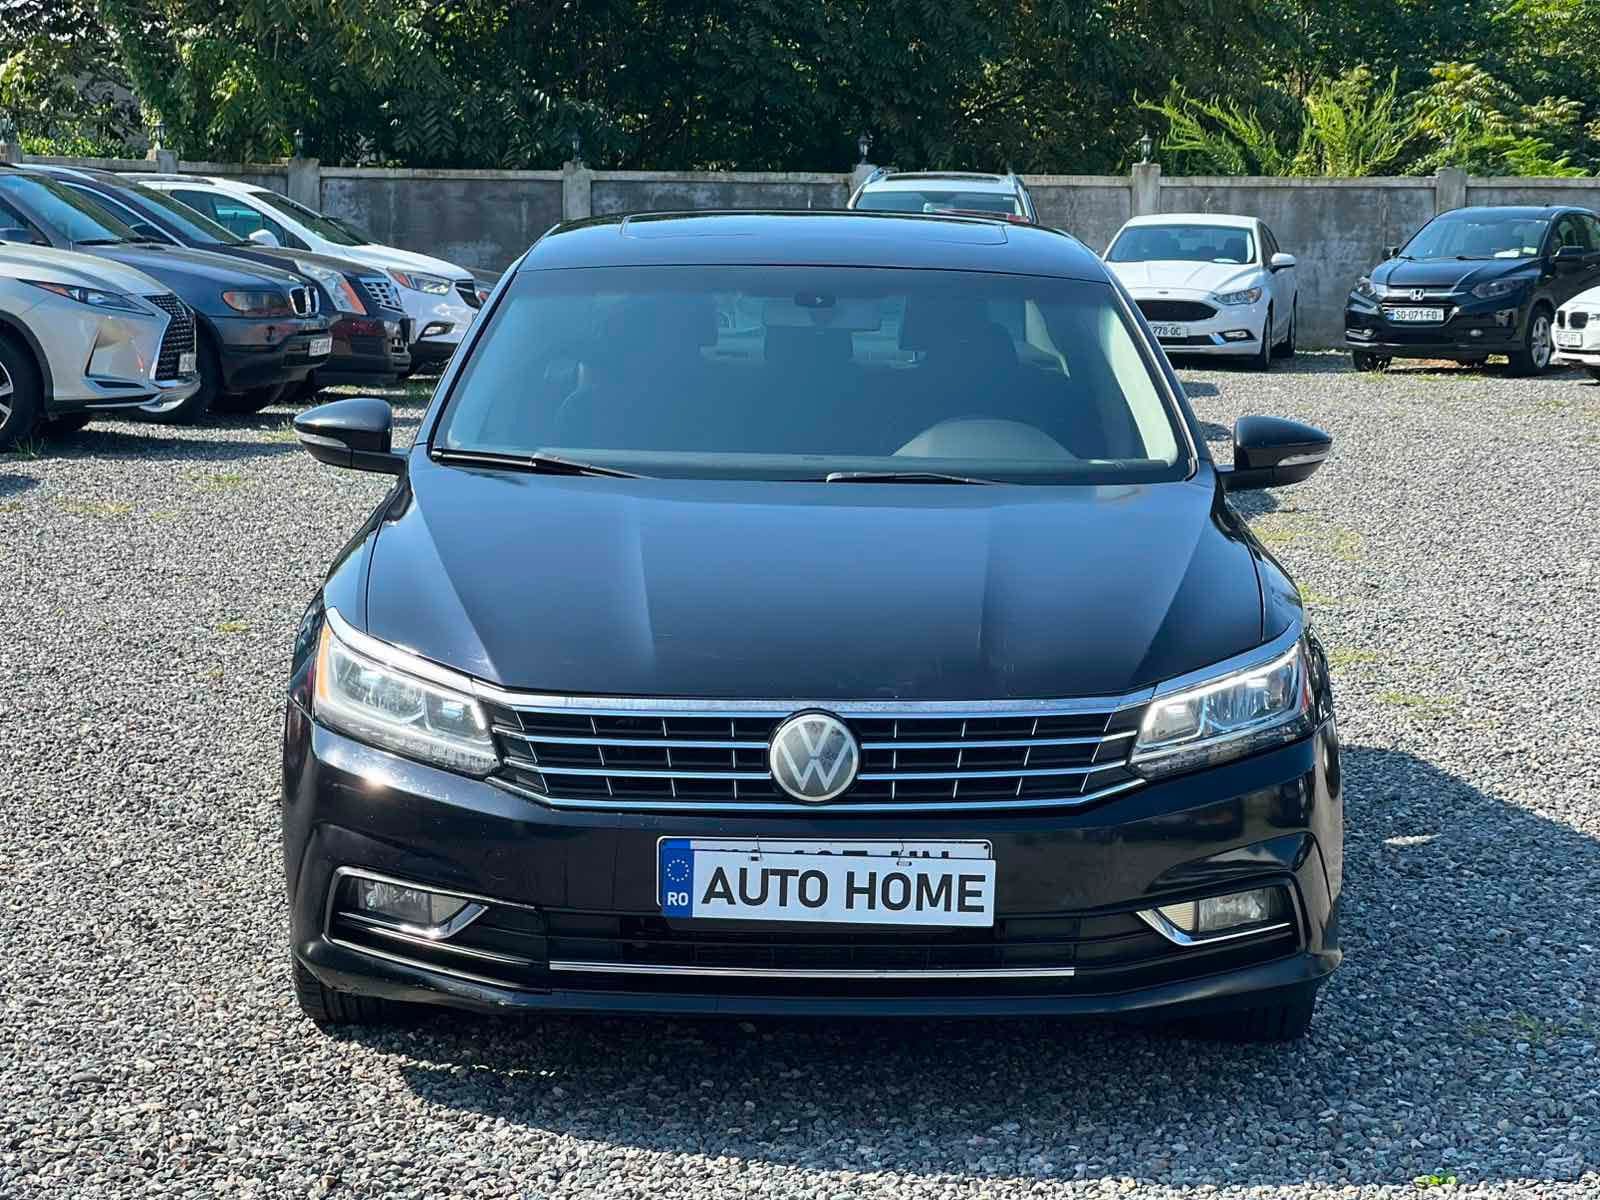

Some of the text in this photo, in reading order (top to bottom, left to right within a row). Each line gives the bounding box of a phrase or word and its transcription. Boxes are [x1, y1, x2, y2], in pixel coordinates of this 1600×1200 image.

[667, 891, 689, 907] RO
[701, 866, 986, 913] AUTO HOME
